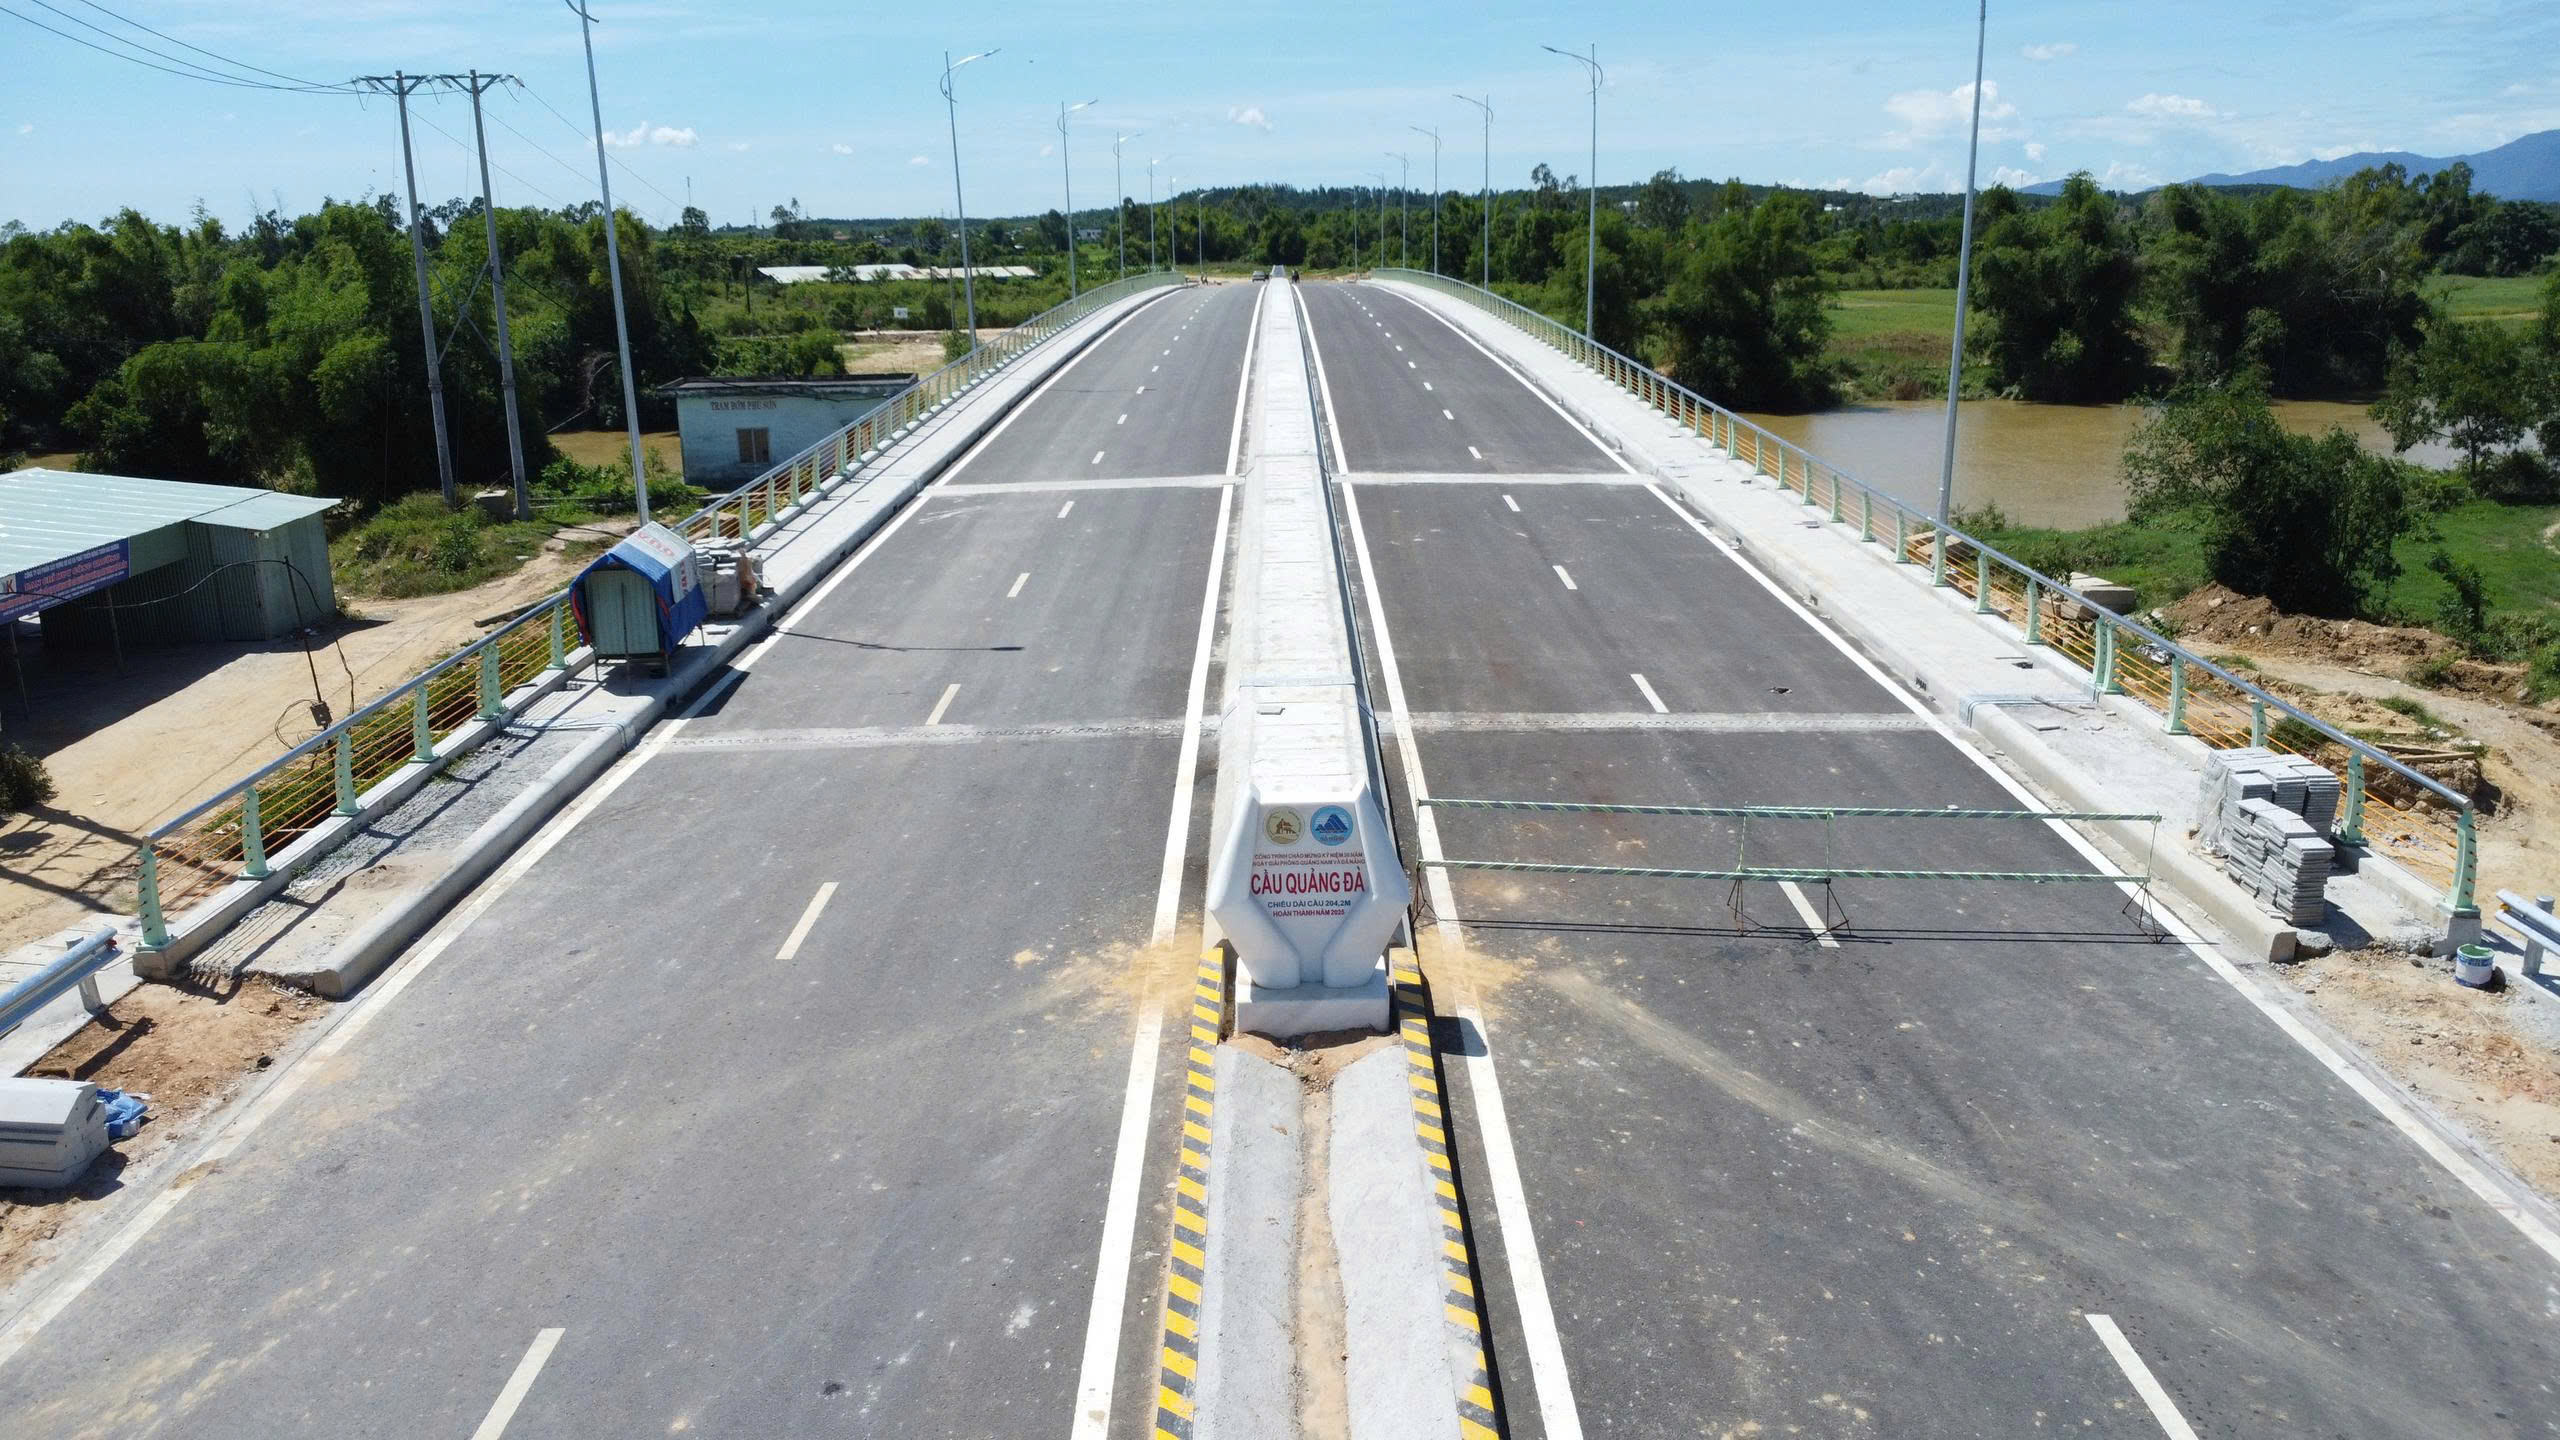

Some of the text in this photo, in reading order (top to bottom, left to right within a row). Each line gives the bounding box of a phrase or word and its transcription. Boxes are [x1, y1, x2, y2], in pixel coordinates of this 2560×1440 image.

[1251, 866, 1365, 895] CẦU QUẢNG ĐÀ
